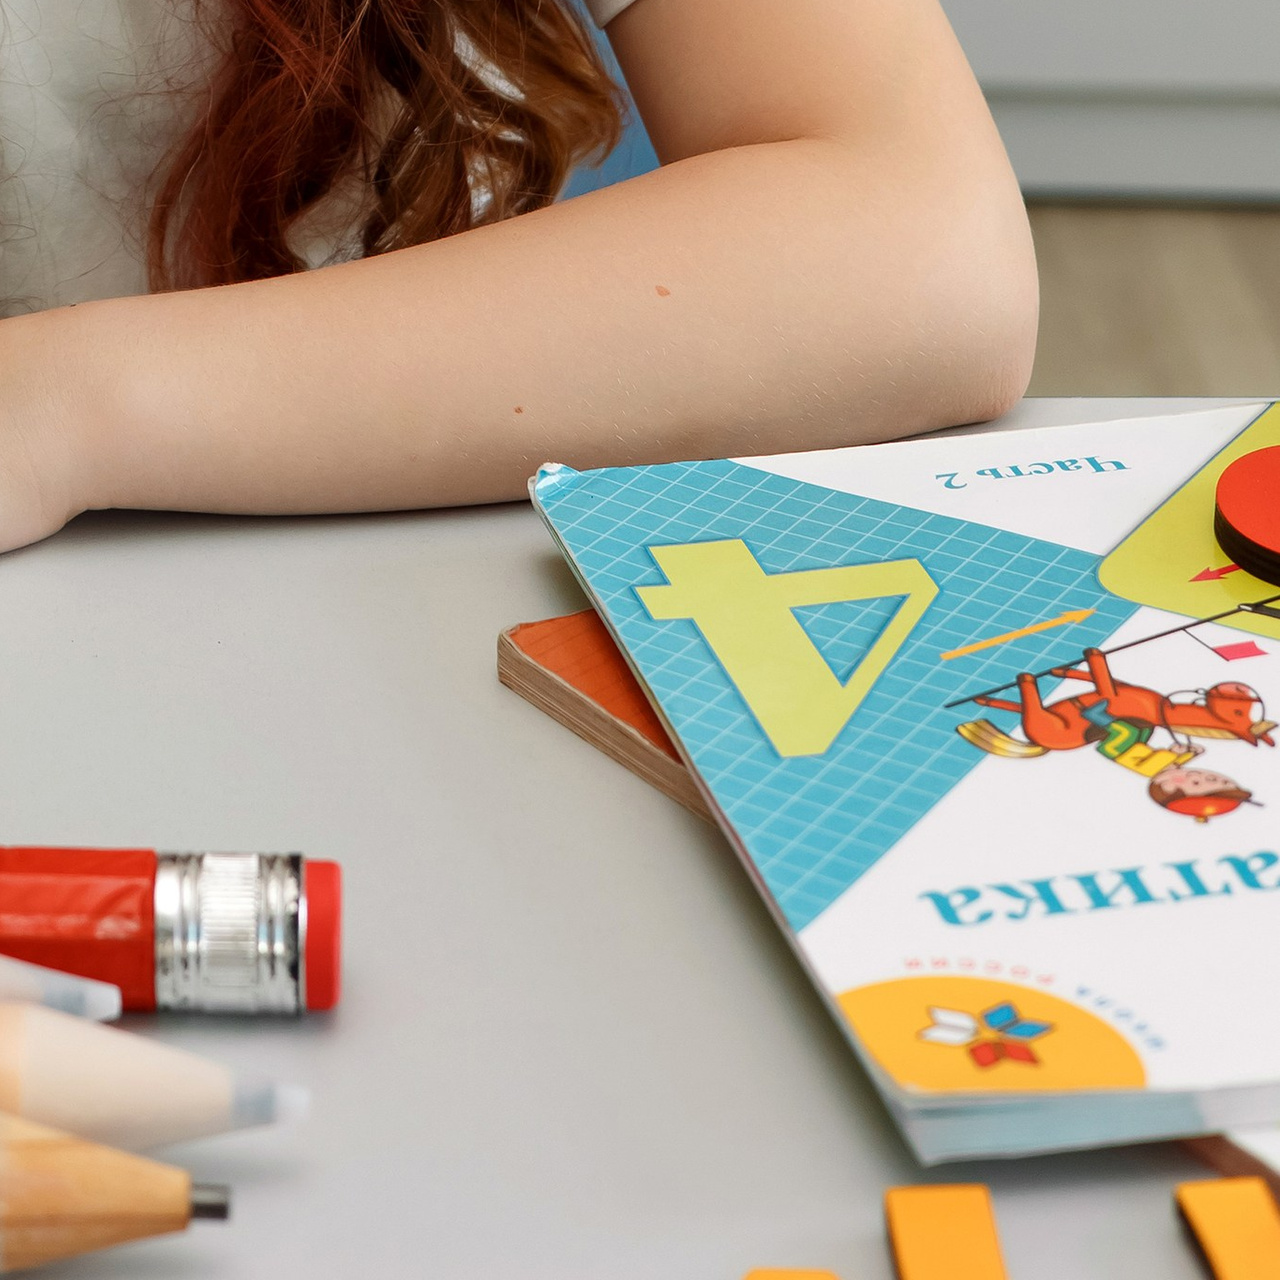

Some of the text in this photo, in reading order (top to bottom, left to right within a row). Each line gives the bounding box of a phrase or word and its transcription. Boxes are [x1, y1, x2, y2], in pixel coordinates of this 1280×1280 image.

[935, 455, 1131, 489] Часть 2
[634, 538, 940, 758] 4
